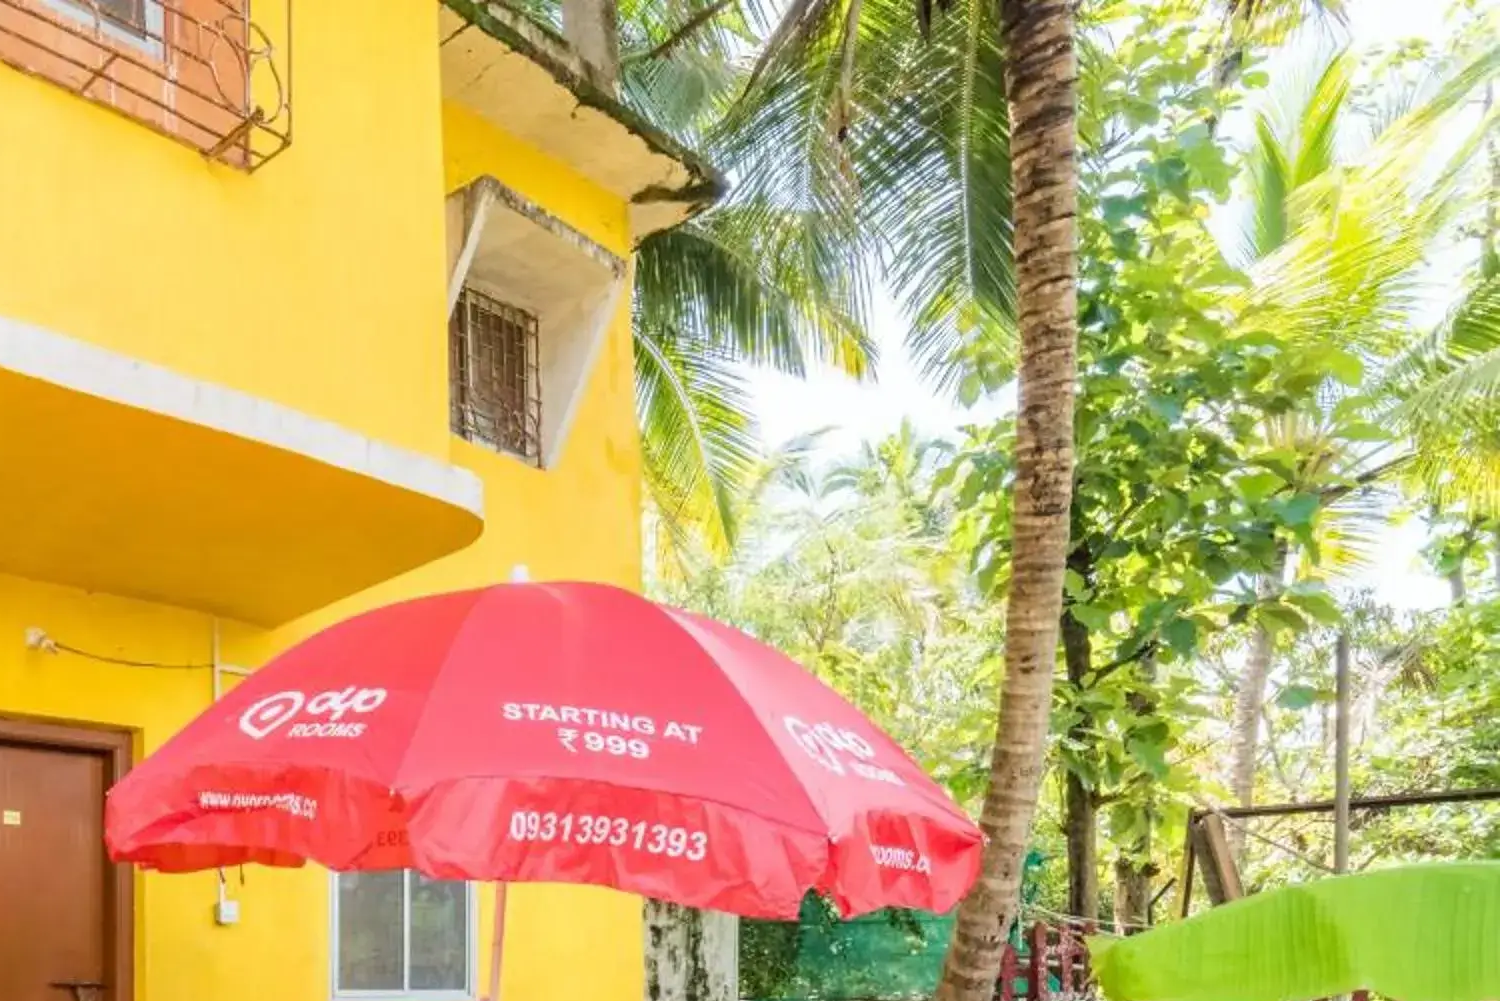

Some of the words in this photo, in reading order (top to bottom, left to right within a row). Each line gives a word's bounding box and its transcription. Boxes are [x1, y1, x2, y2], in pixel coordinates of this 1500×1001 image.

[288, 723, 367, 738] ROOMS
[502, 702, 655, 736] STARTING
[663, 721, 703, 744] AT
[510, 811, 708, 861] 09313931393
